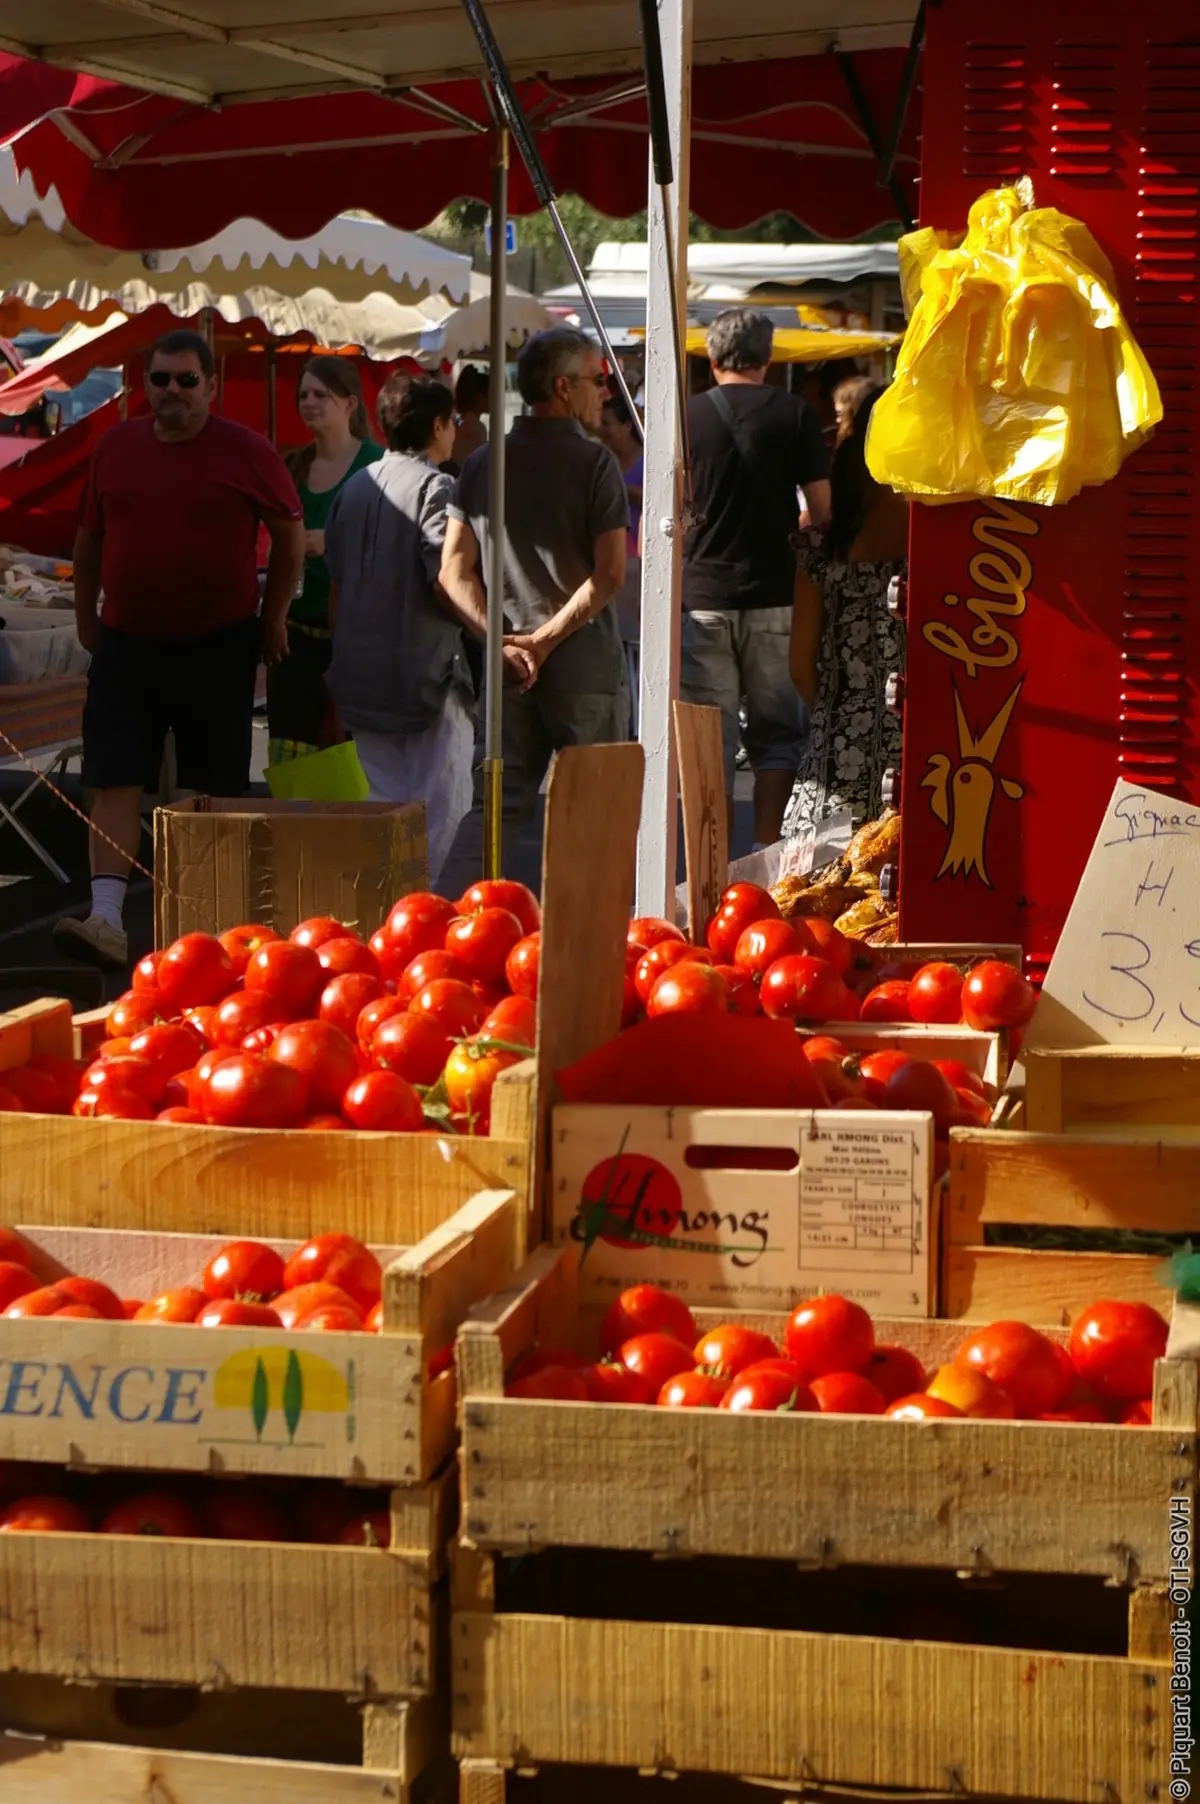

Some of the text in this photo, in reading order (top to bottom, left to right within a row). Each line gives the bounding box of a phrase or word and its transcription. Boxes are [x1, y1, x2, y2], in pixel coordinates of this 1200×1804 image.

[807, 1133, 833, 1142] ARL
[837, 1132, 879, 1144] HMONG
[569, 1167, 769, 1268] Hmong
[0, 1360, 208, 1425] ENCE
